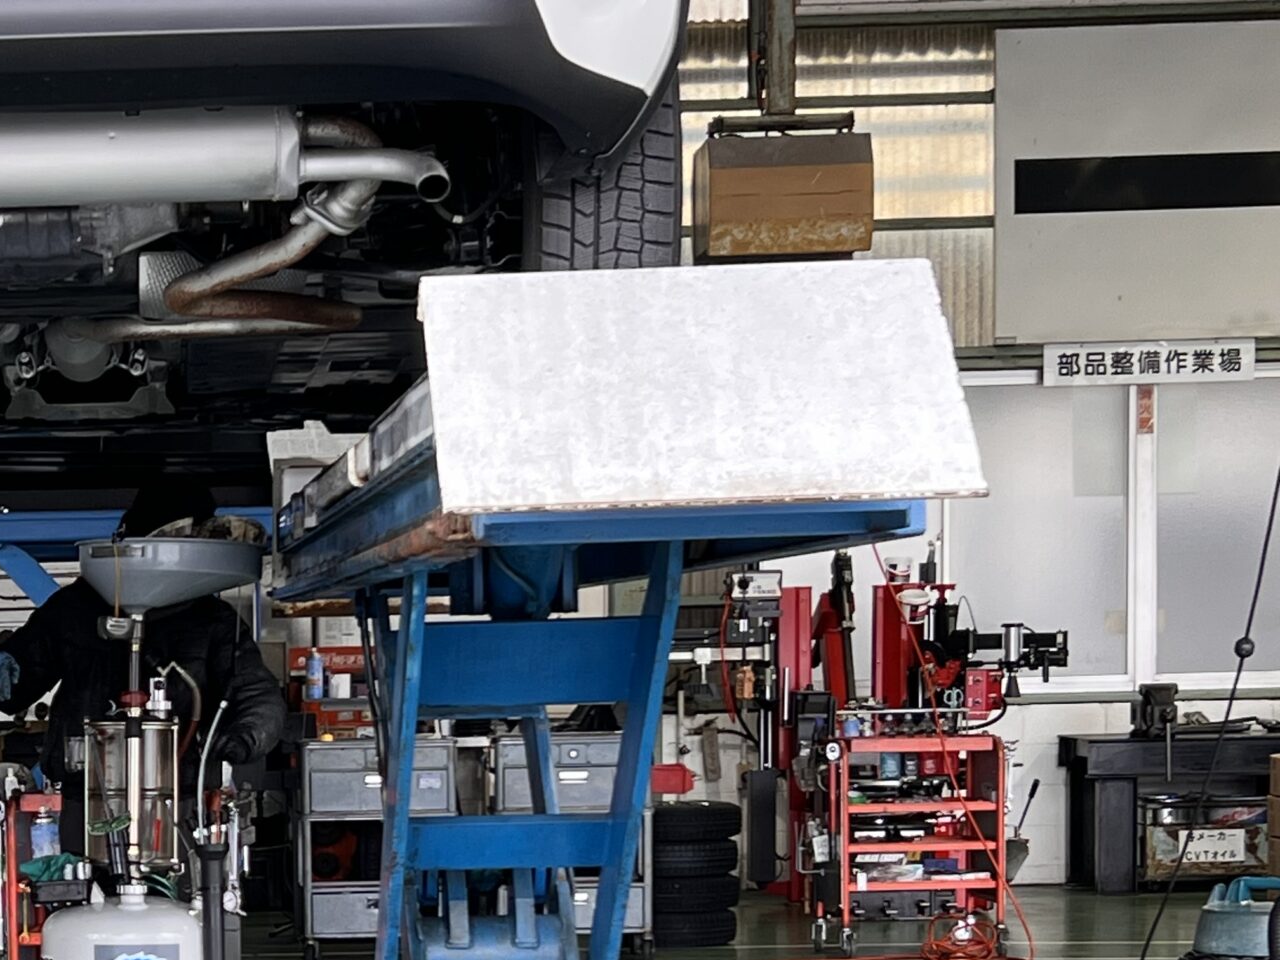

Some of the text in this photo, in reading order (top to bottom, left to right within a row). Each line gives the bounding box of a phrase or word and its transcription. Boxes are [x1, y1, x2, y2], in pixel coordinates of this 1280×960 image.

[1057, 348, 1242, 377] 部品整備作業場
